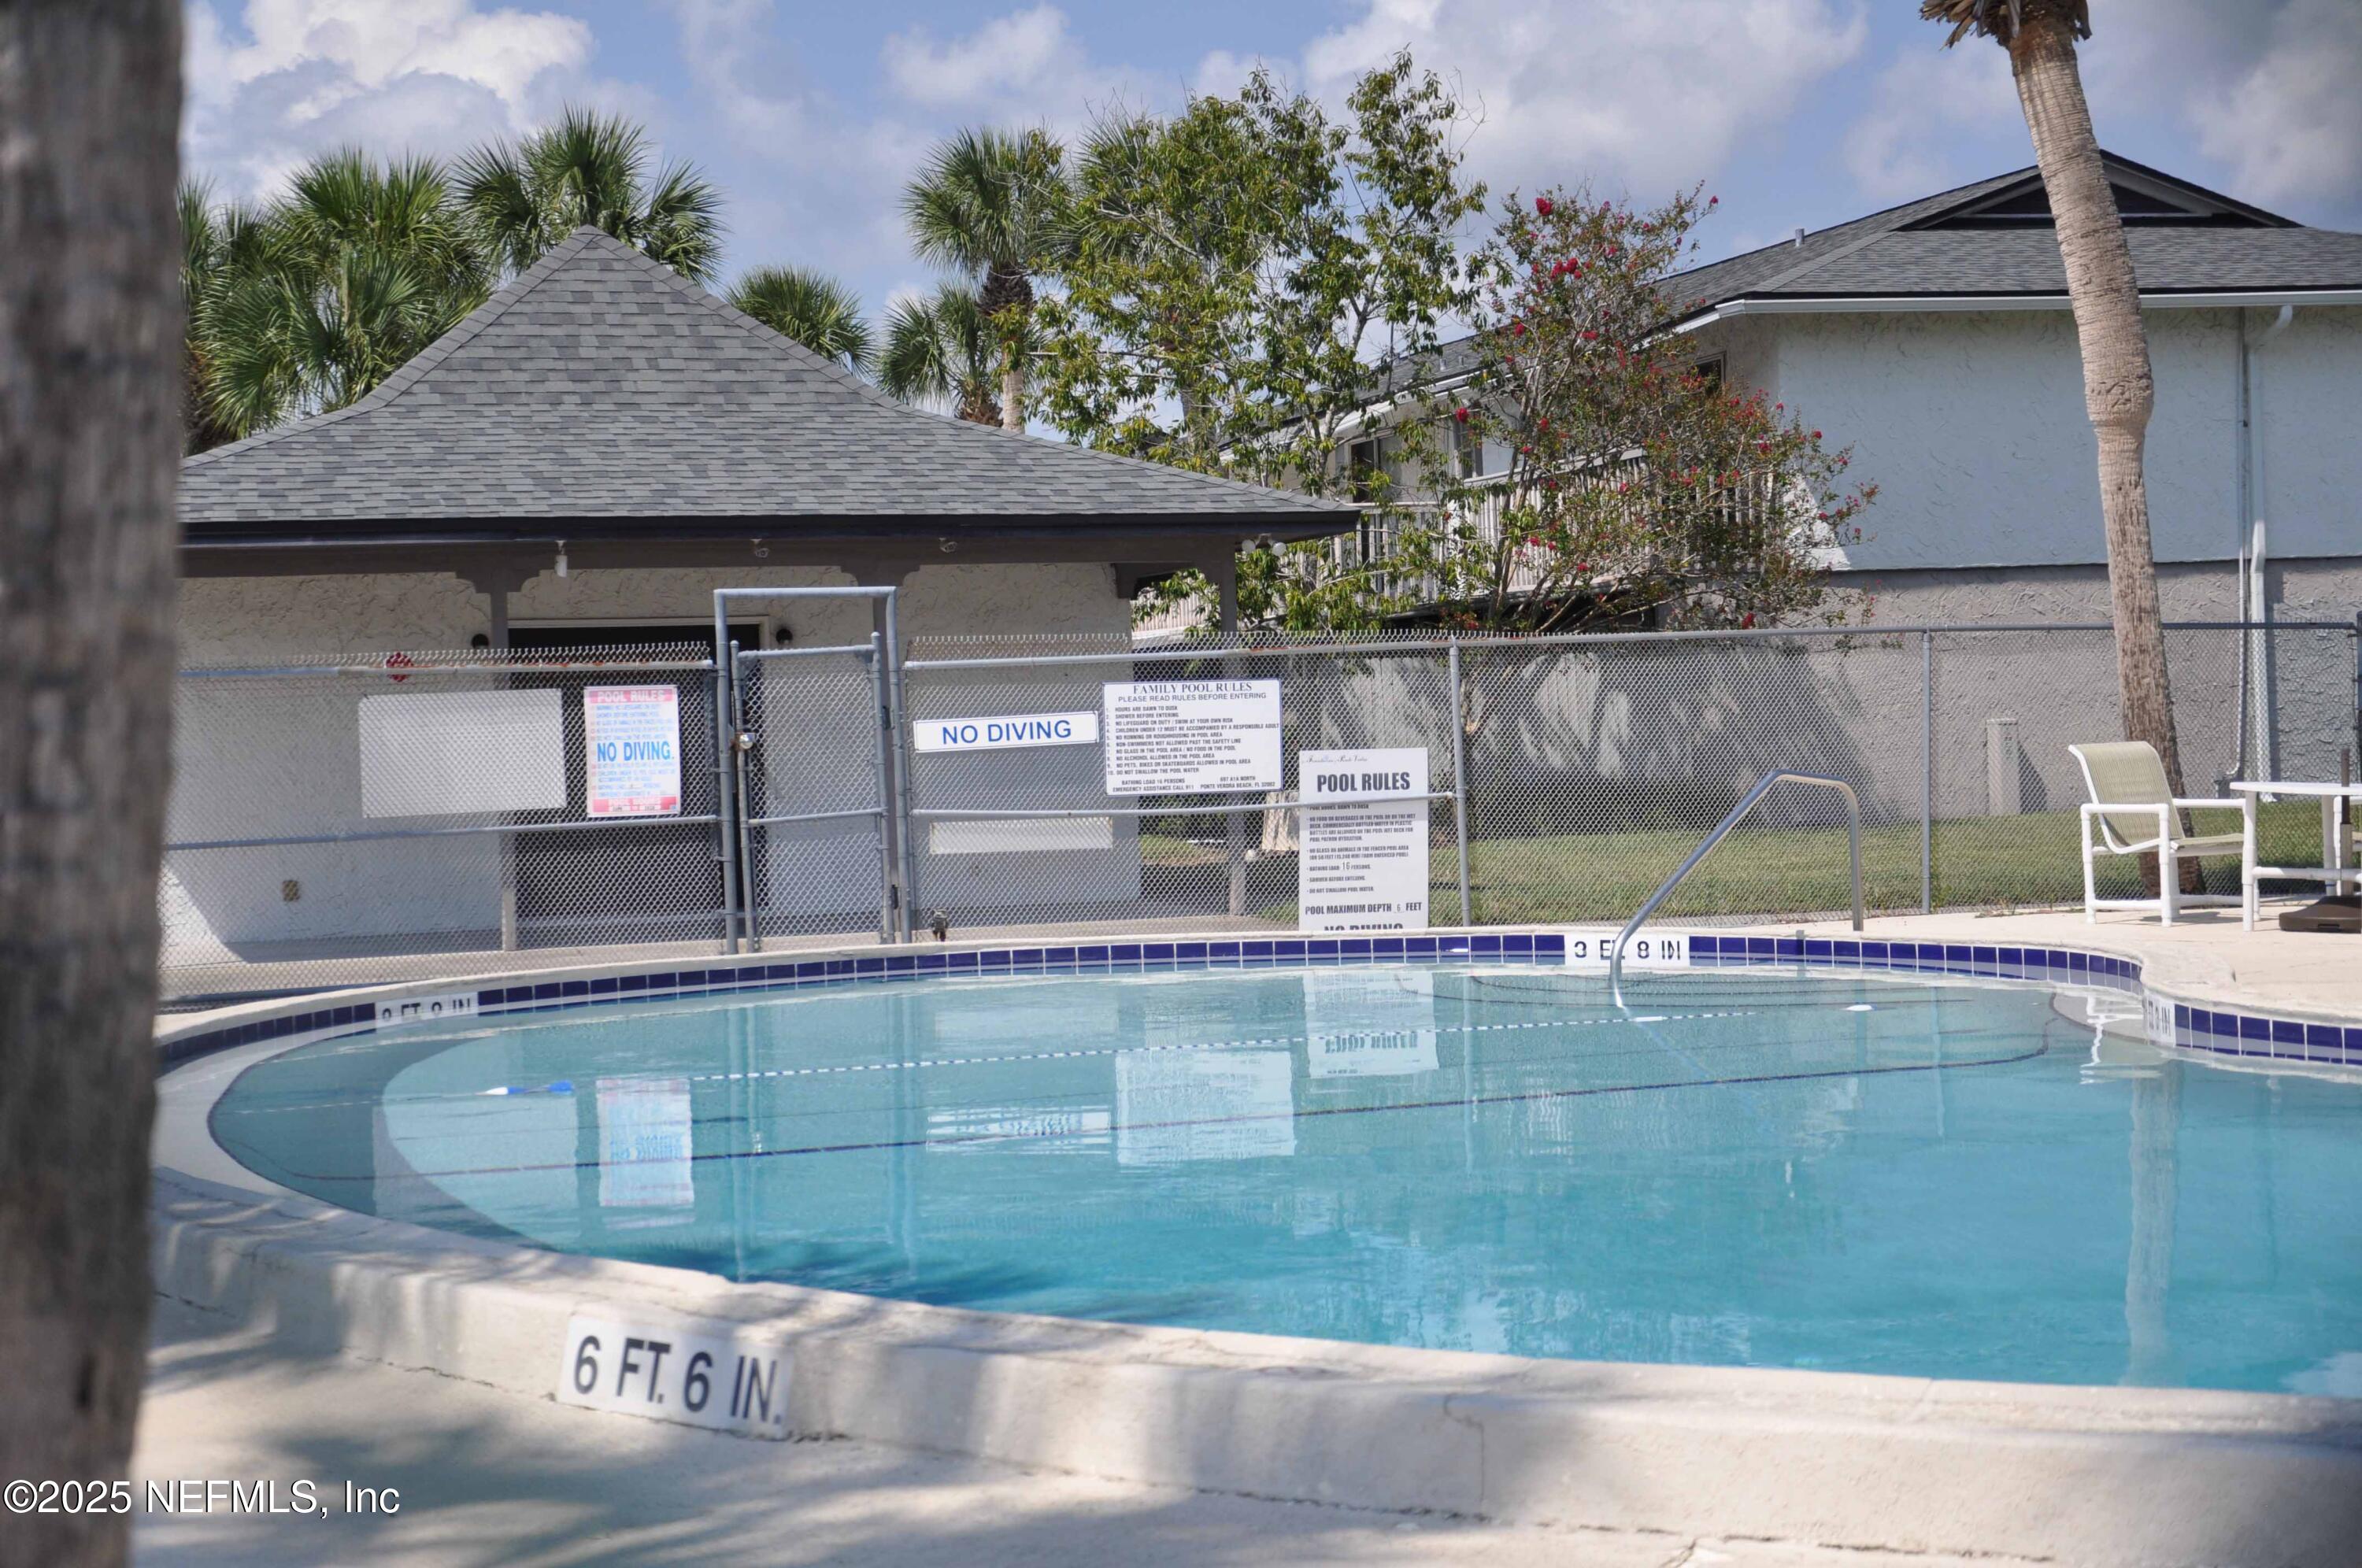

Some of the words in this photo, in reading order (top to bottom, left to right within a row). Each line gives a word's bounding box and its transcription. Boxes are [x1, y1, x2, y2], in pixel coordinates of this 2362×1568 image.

[598, 690, 628, 702] POOL
[631, 690, 665, 701] RULES
[1134, 684, 1178, 694] FAMILY
[1182, 683, 1213, 693] POOL
[1216, 682, 1252, 692] RULES
[942, 725, 979, 745] NO
[987, 719, 1072, 742] DIVING
[597, 741, 617, 762] NO
[1317, 773, 1357, 793] POOL
[1361, 771, 1411, 791] RULES
[1305, 905, 1325, 915] POOL
[1327, 904, 1366, 914] MAXIMUM
[1368, 903, 1392, 912] DEPTH
[1405, 902, 1422, 911] FEET
[573, 1335, 602, 1395] 6
[616, 1337, 672, 1404] FT.
[683, 1351, 713, 1413] 6
[730, 1355, 782, 1425] IN.
